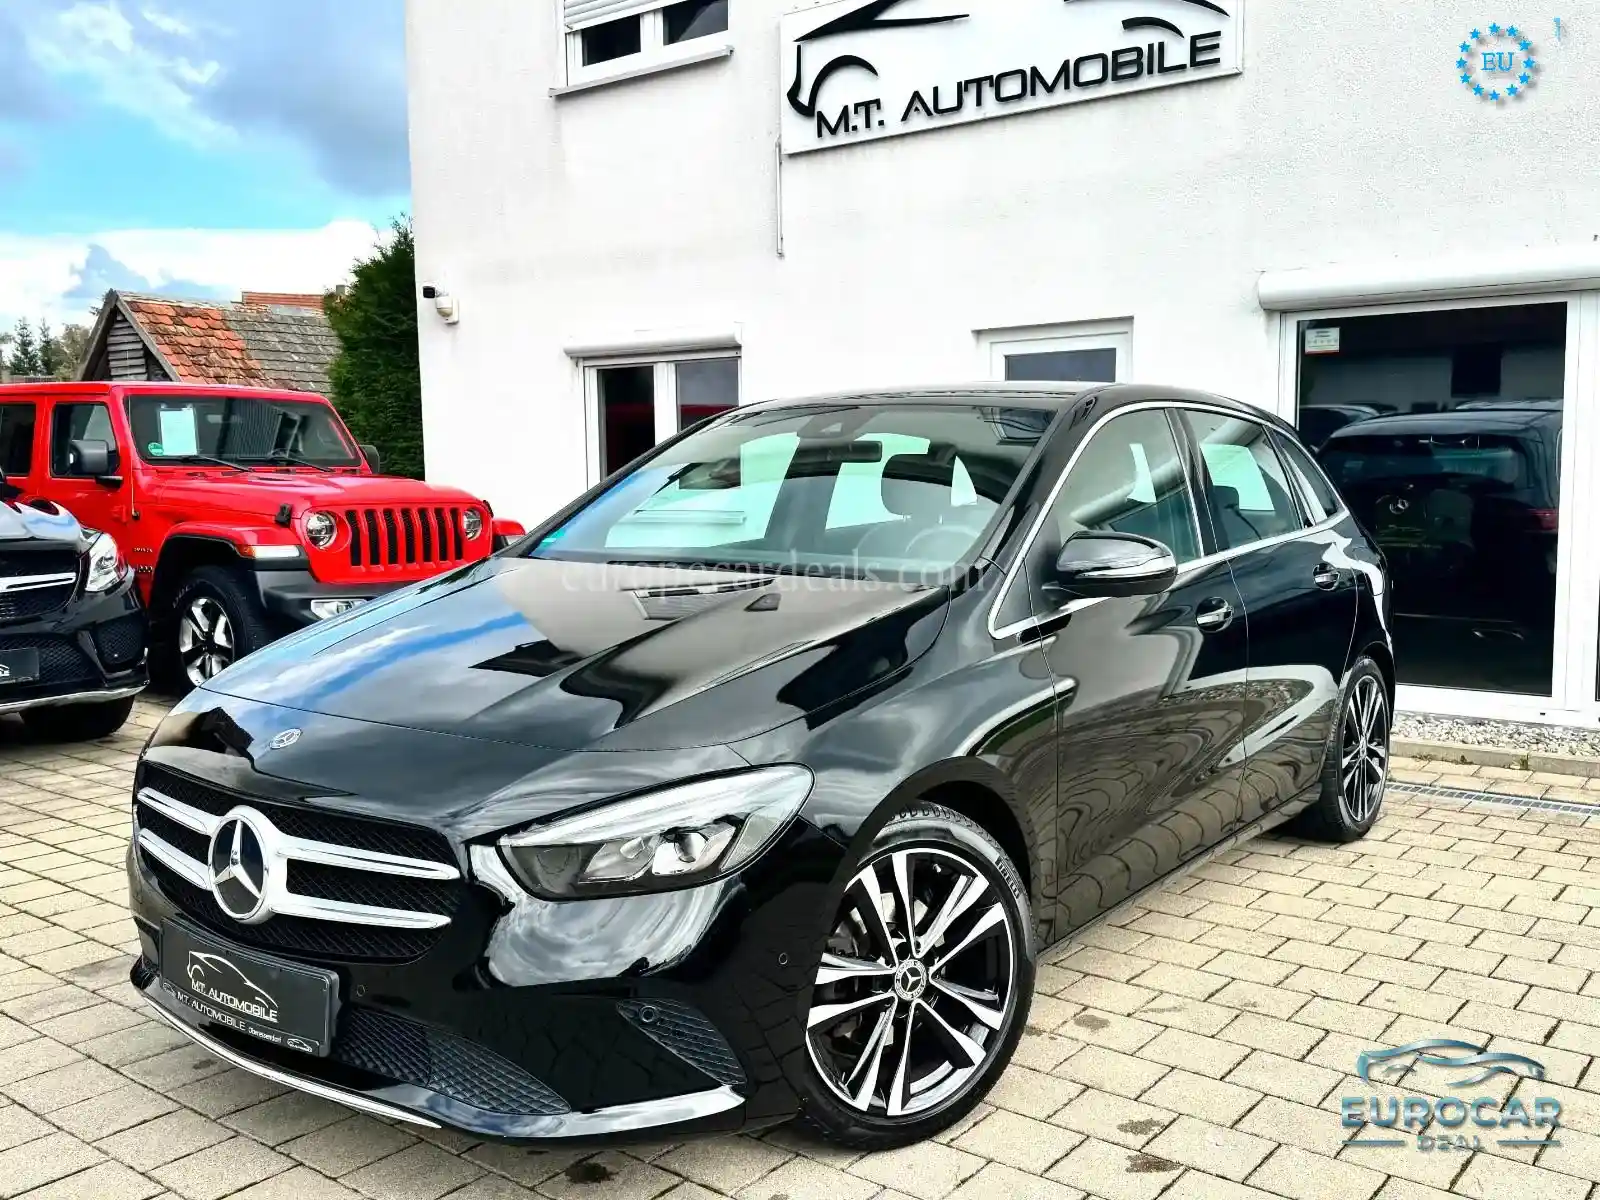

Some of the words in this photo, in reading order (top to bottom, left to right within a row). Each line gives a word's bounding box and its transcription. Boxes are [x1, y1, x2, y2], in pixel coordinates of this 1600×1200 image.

[816, 97, 885, 138] M.T.
[901, 30, 1222, 122] AUTOMOBILE
[191, 1000, 246, 1031] AUTOMOBILE
[208, 988, 279, 1023] AUTOMOBILE
